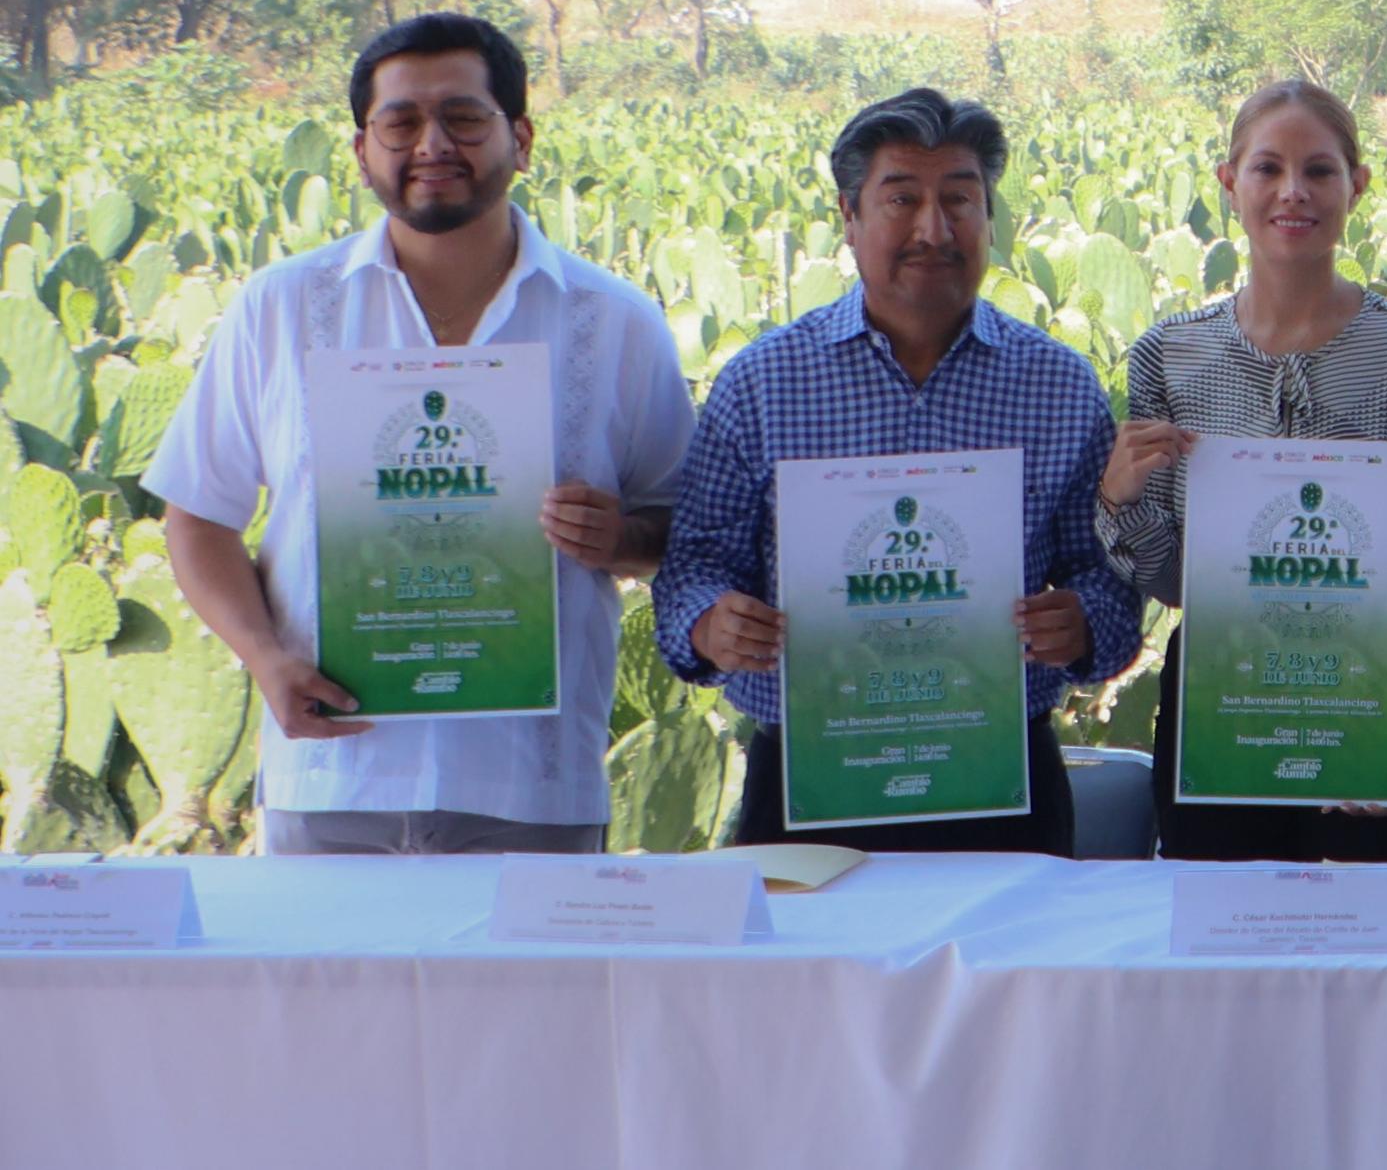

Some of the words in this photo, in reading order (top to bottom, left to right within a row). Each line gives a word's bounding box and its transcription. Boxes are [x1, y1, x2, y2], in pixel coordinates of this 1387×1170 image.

[1272, 541, 1328, 555] FERIA
[1247, 555, 1370, 588] NOPAL
[1287, 652, 1303, 670] 8
[1305, 655, 1321, 672] y
[1324, 653, 1340, 671] 9
[1262, 670, 1286, 685] DE
[1289, 670, 1340, 686] JUNIO
[1221, 695, 1240, 704] San
[1243, 695, 1300, 706] Bernardino
[1302, 697, 1378, 709] Tlaxcalancingo
[1273, 727, 1297, 736] Gran
